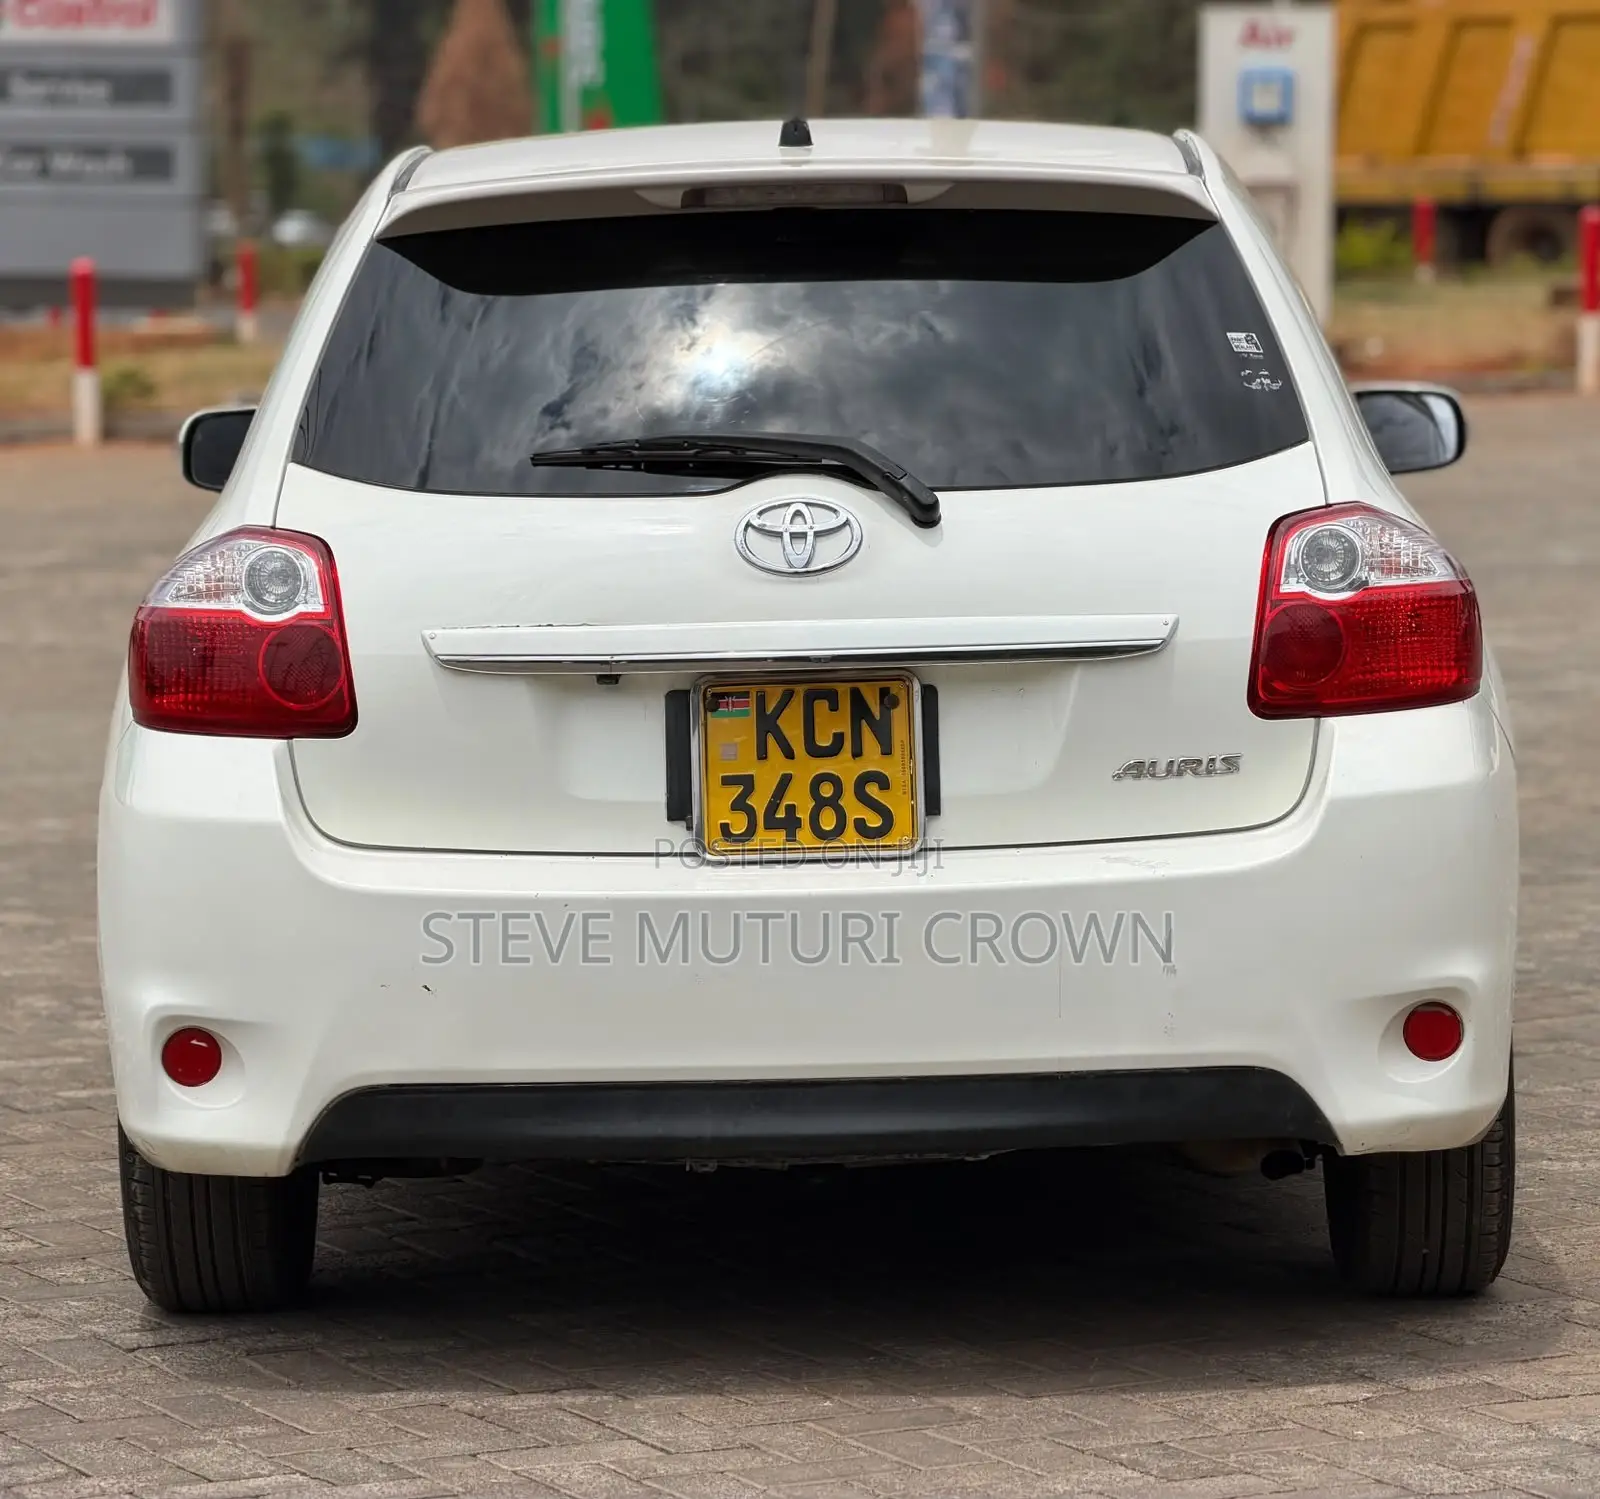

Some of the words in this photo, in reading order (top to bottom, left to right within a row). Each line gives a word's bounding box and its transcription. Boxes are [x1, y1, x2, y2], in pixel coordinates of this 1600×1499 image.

[756, 687, 893, 760] KCN
[1111, 753, 1242, 781] AURIS
[719, 770, 895, 843] 348S
